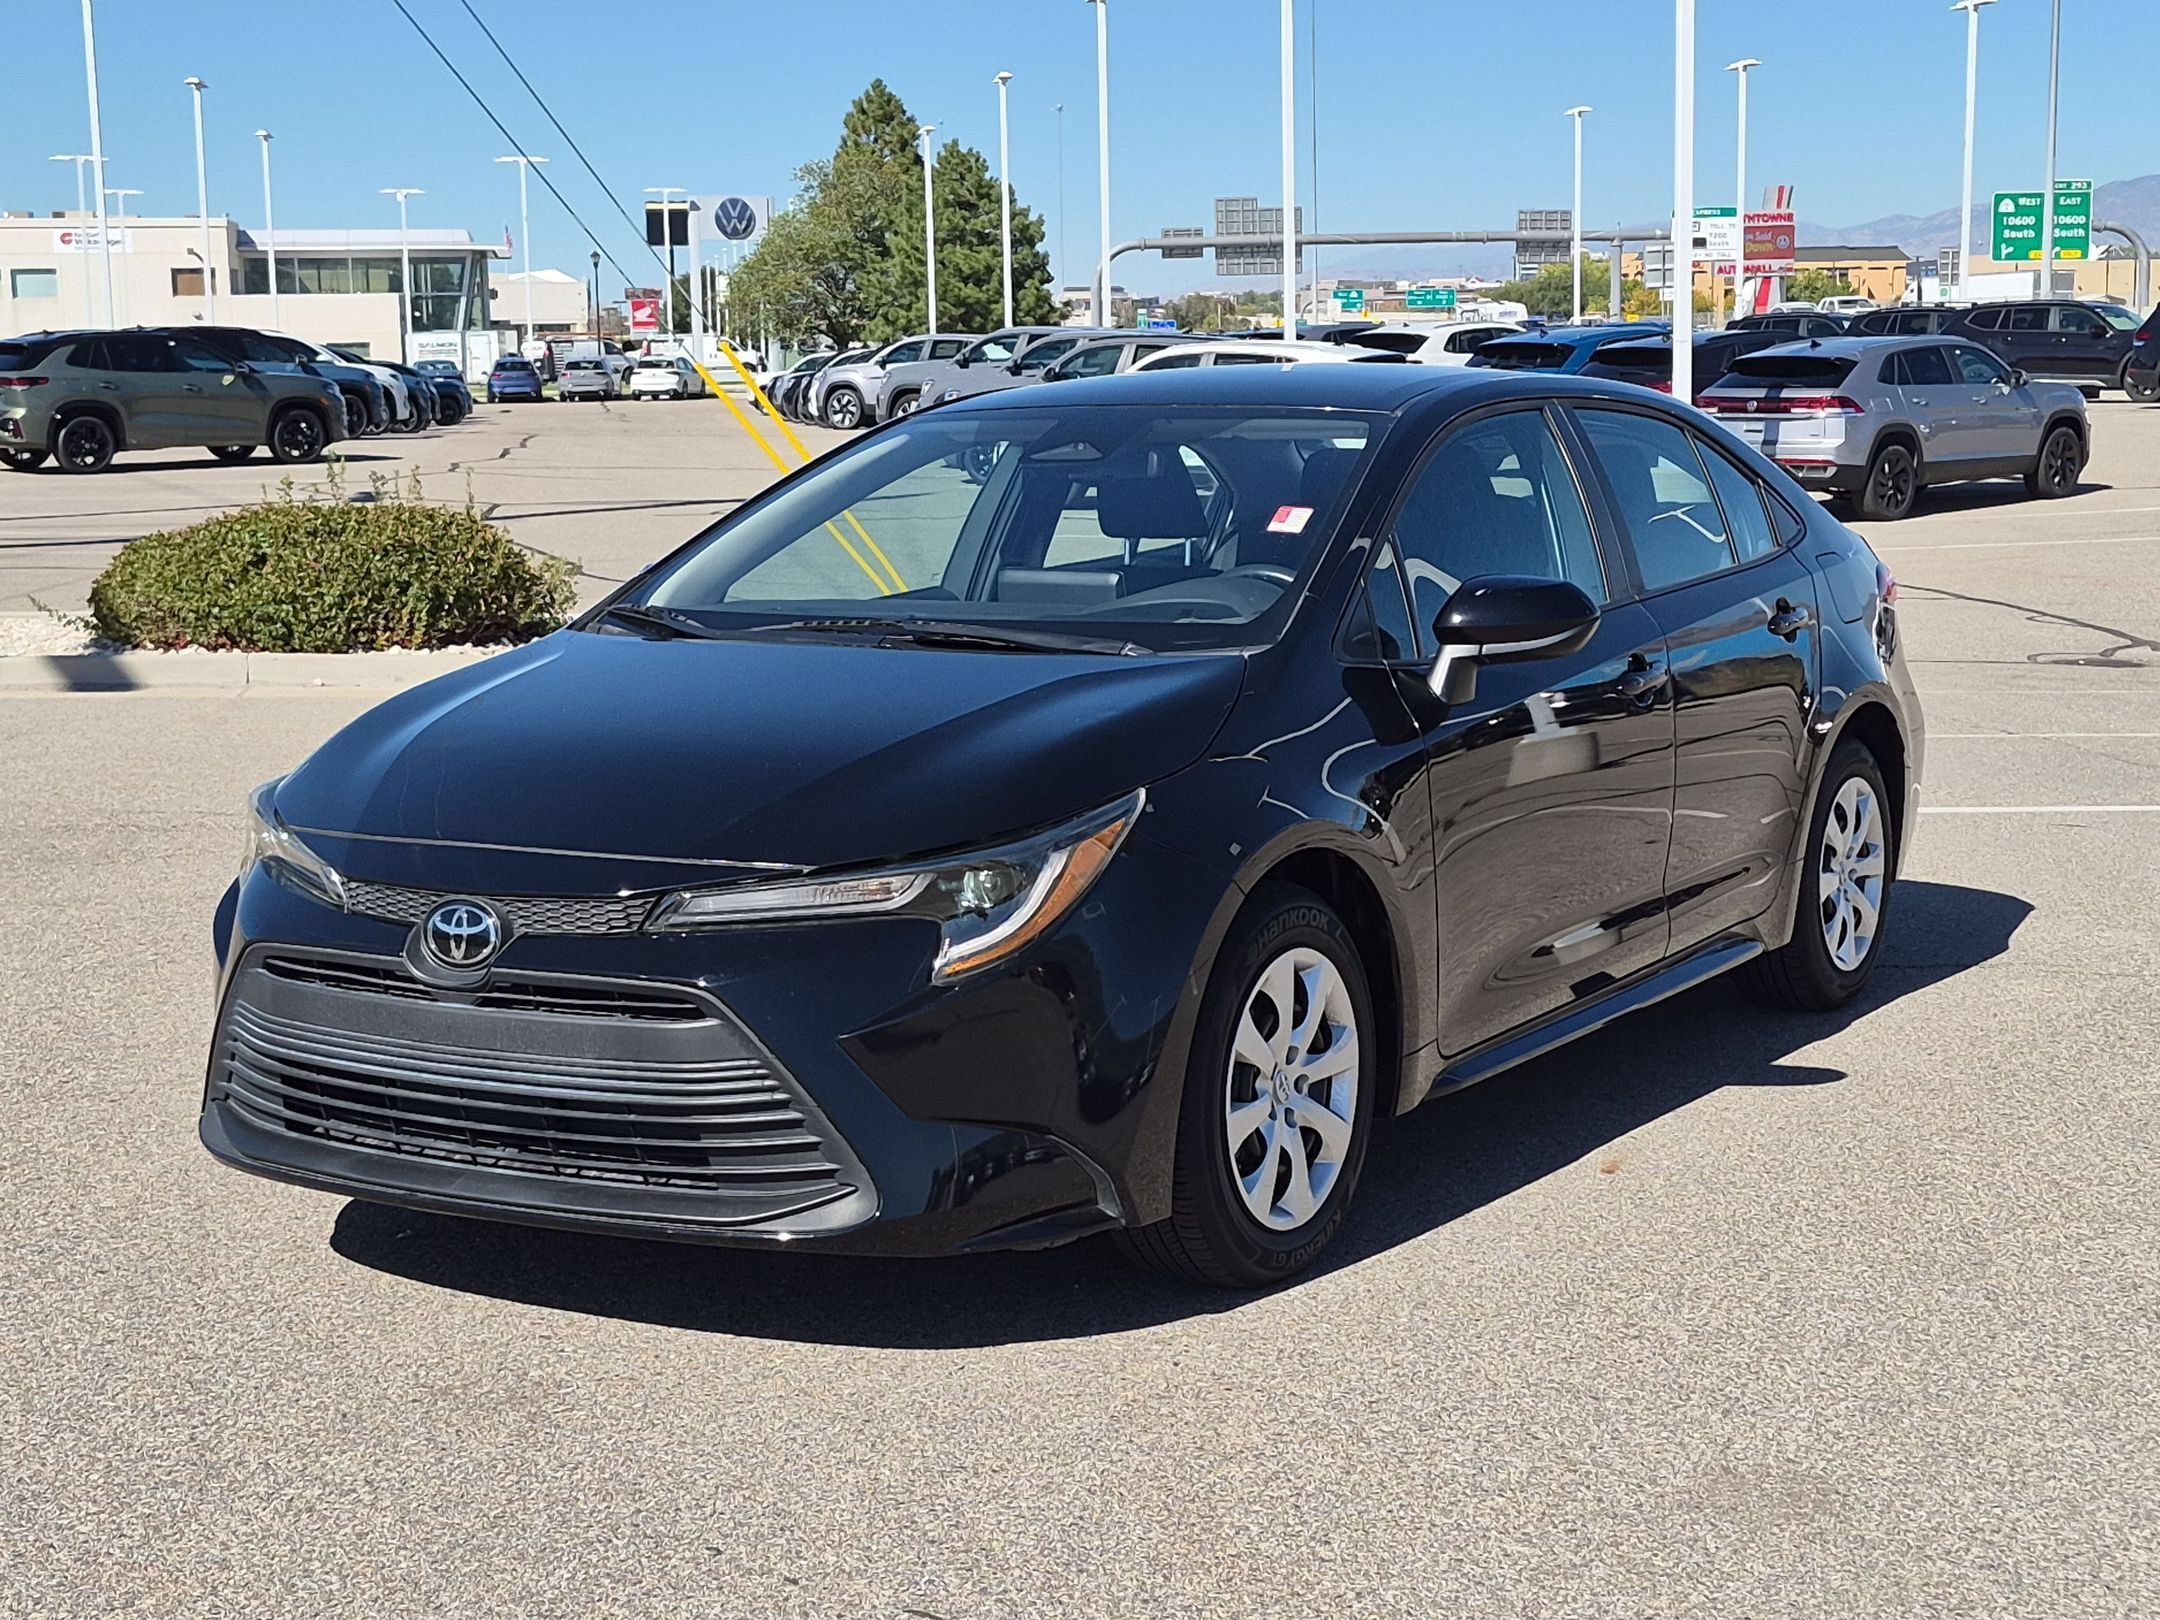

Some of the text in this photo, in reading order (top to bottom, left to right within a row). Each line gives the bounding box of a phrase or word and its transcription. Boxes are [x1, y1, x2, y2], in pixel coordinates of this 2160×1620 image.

[2018, 197, 2041, 206] WEST
[2059, 196, 2081, 205] EAST
[2003, 215, 2036, 226] 10600
[2053, 215, 2086, 225] 10600
[2002, 229, 2036, 239] South
[2053, 228, 2085, 238] South
